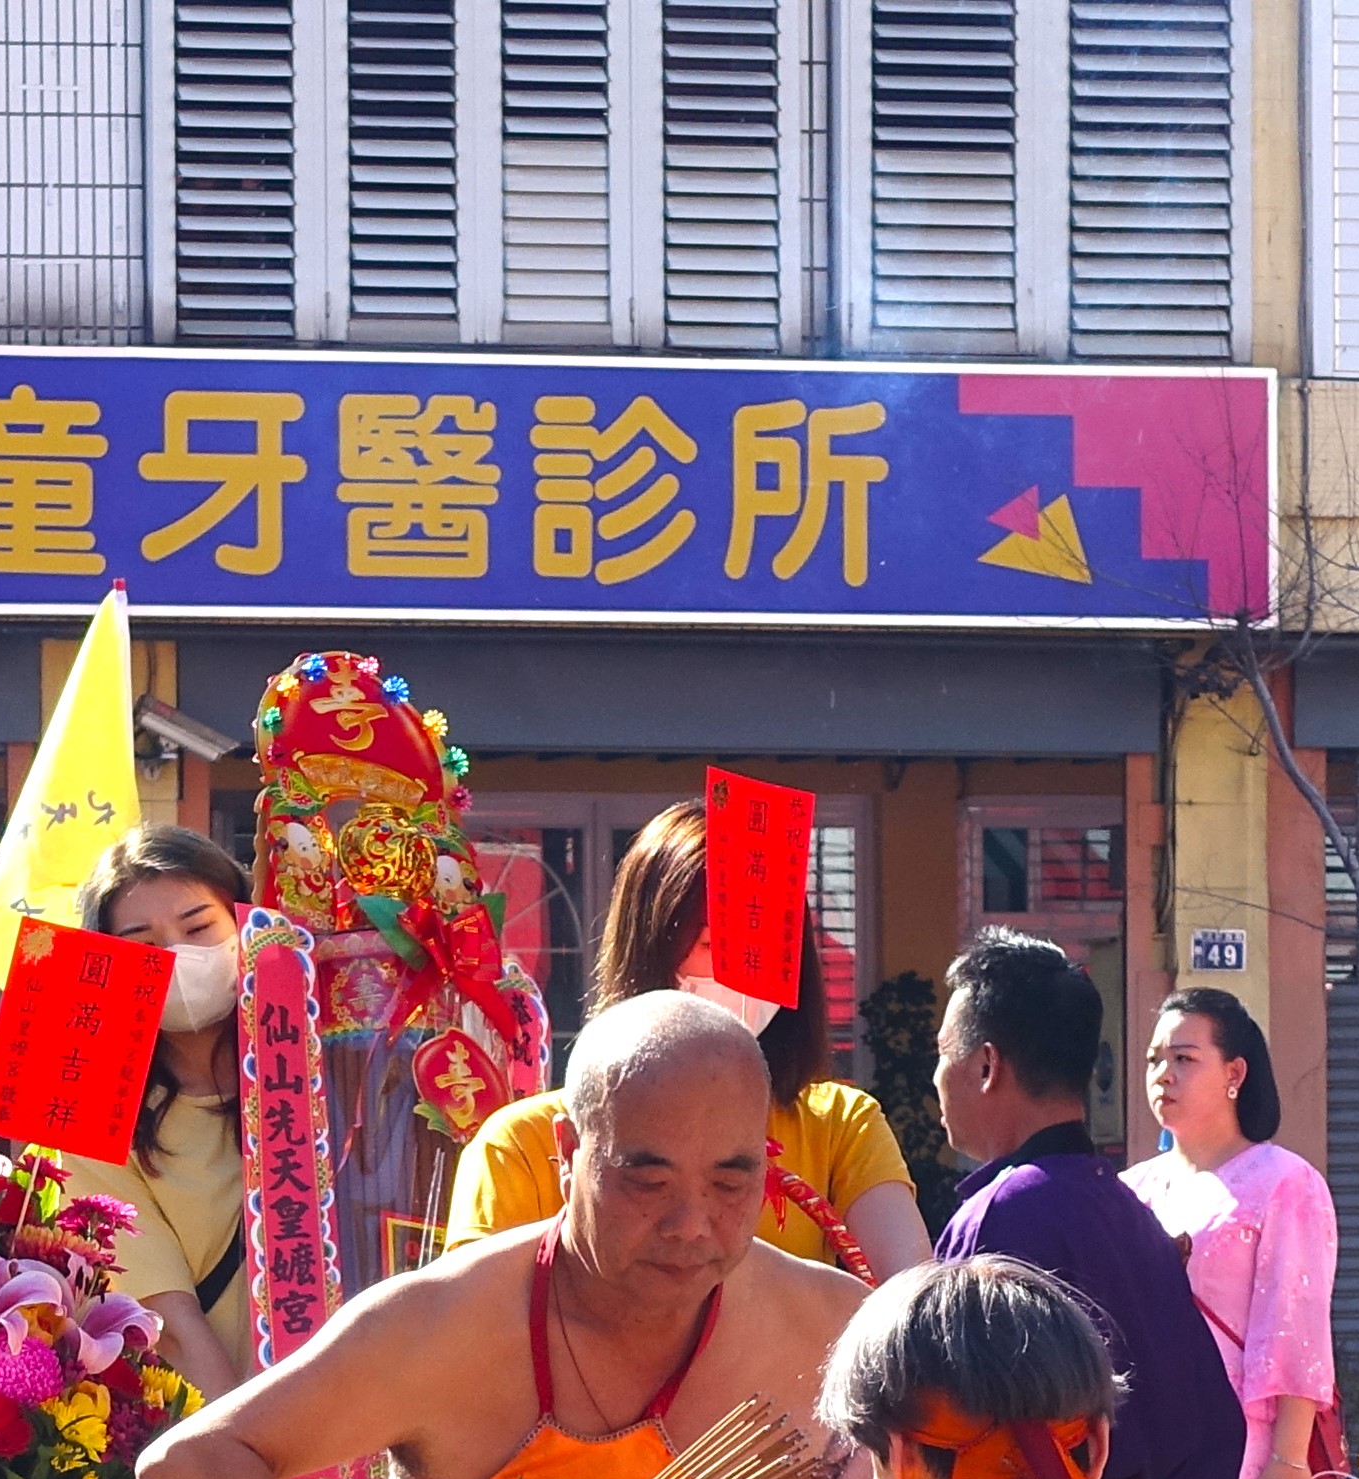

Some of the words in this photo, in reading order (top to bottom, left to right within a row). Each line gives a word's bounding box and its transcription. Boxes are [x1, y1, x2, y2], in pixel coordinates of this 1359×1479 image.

[744, 800, 768, 981] 圓滿吉祥
[1206, 943, 1238, 967] 49
[44, 950, 112, 1132] 圓滿吉祥
